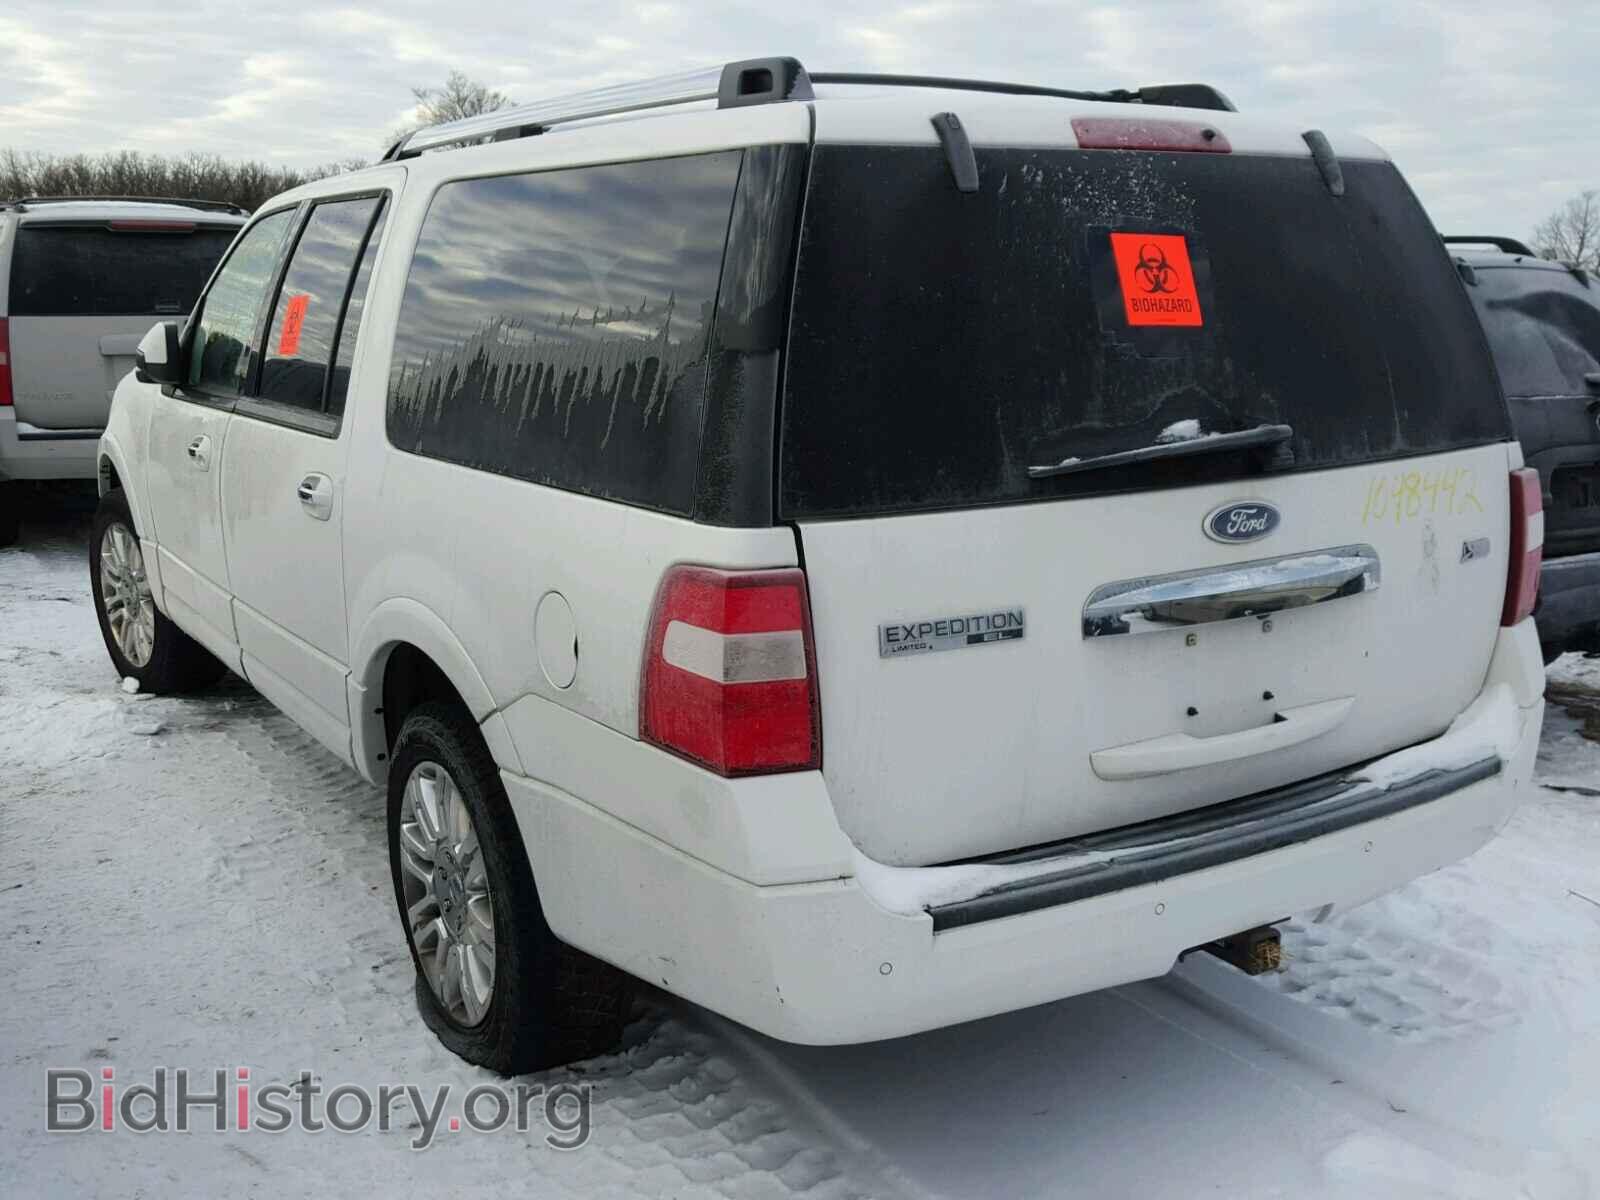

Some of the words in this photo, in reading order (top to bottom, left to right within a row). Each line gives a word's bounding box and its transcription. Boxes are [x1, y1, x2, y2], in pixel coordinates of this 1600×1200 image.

[1131, 298, 1193, 313] BIOHAZARD
[1226, 507, 1268, 534] Ford
[885, 610, 1024, 643] EXPEDITION
[891, 643, 927, 653] LIMITED
